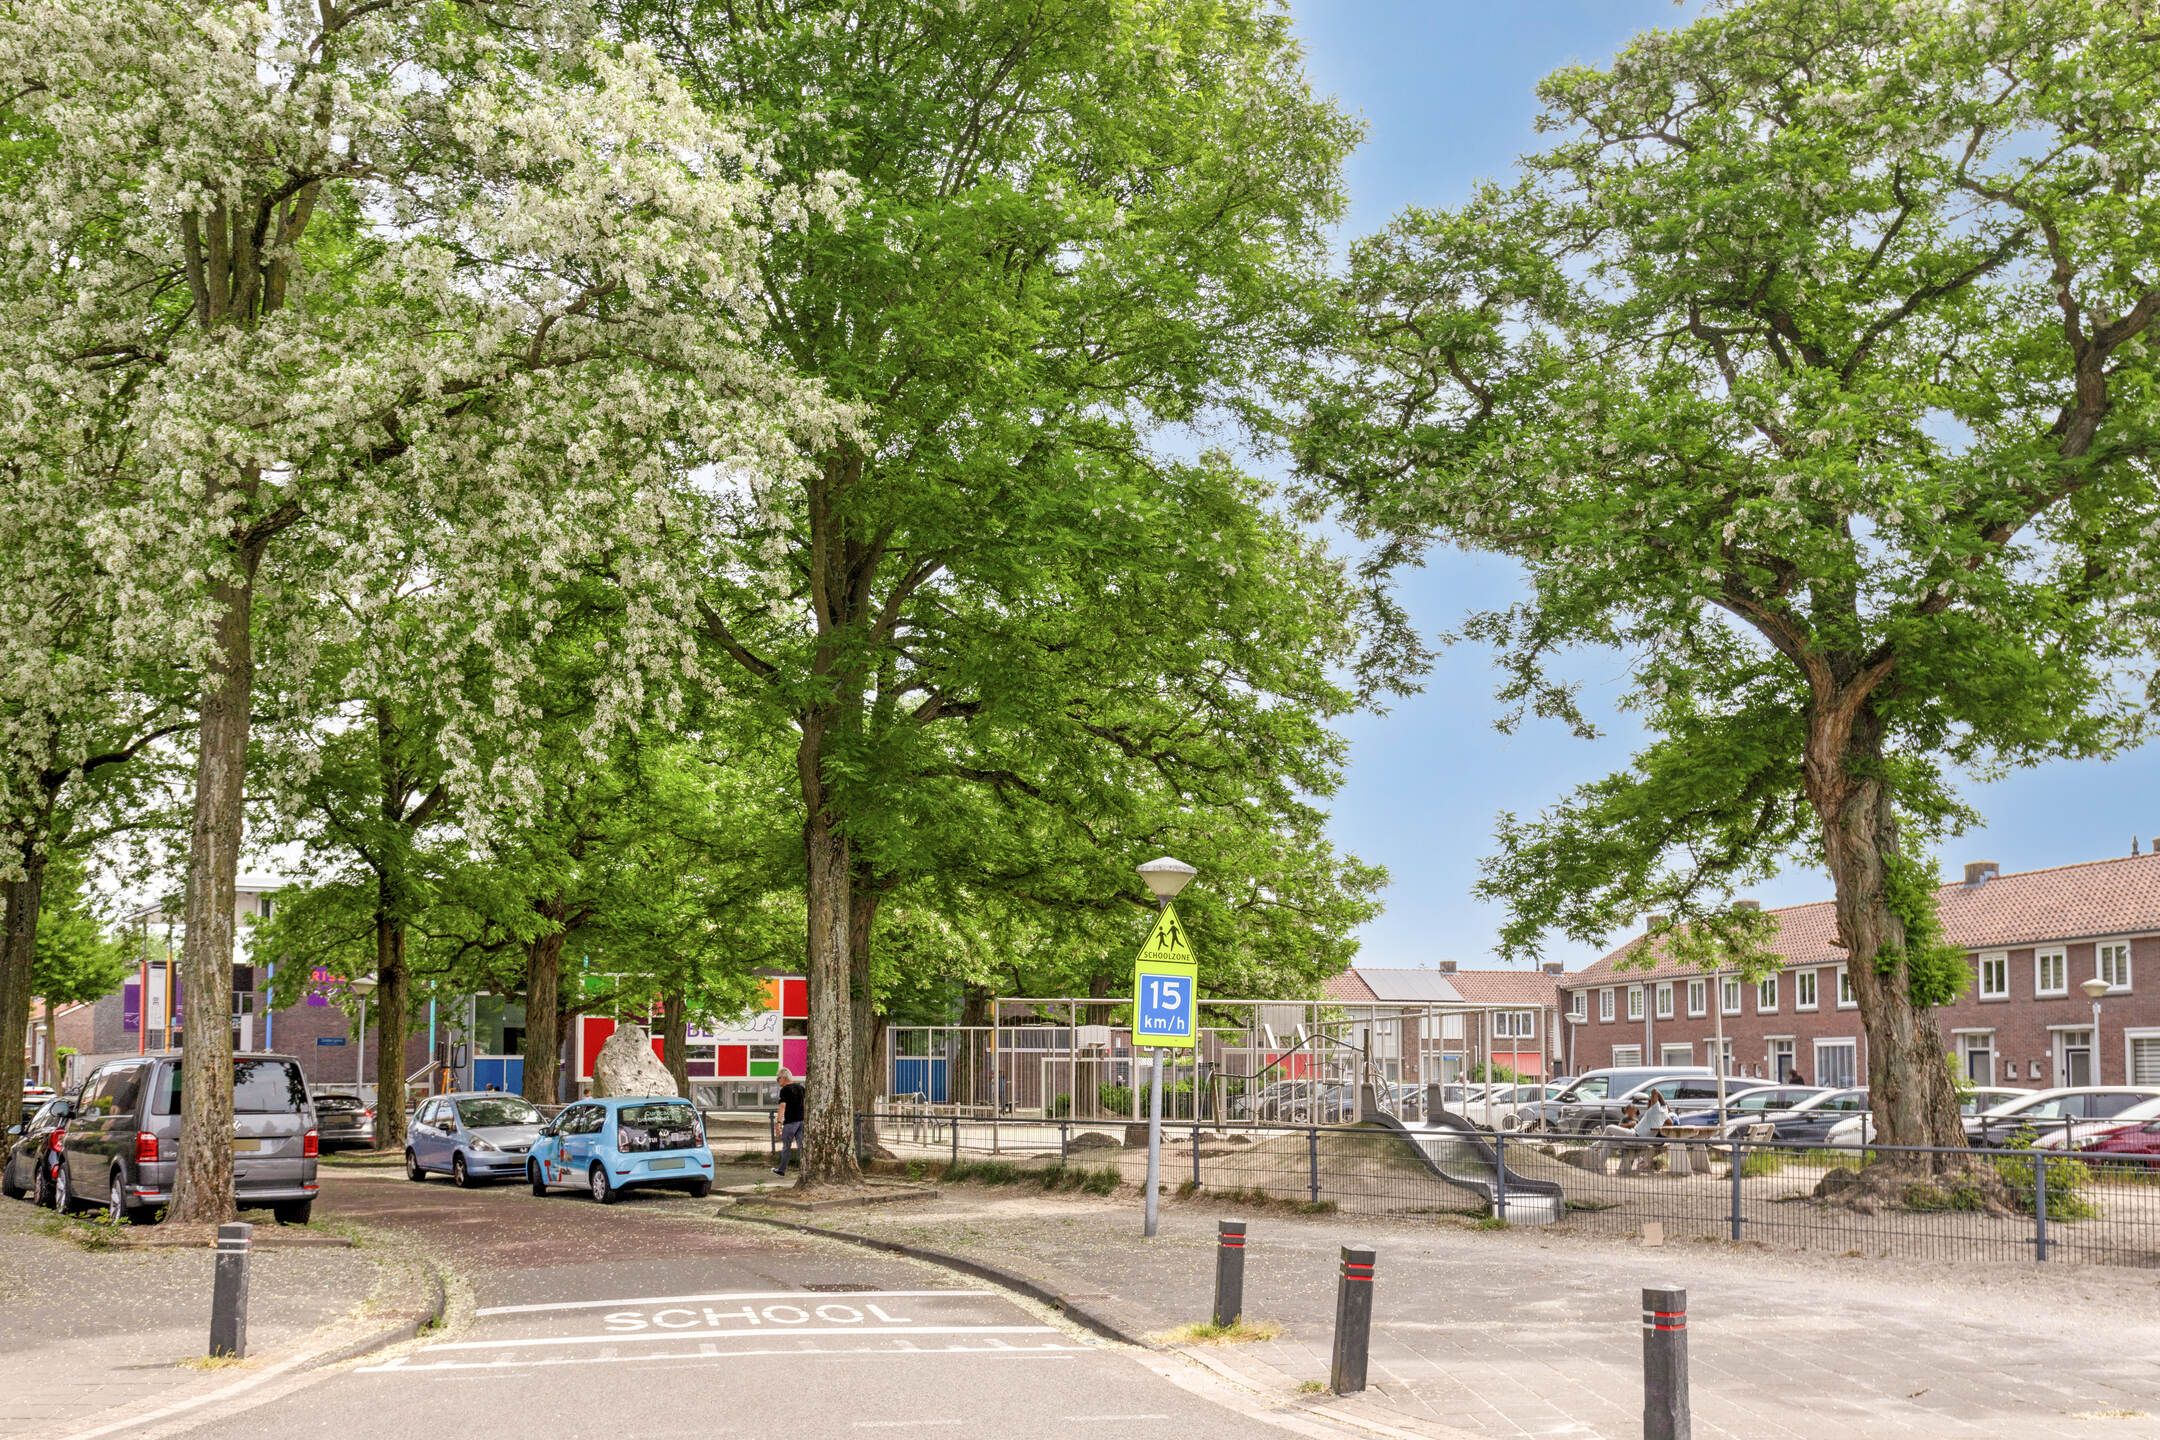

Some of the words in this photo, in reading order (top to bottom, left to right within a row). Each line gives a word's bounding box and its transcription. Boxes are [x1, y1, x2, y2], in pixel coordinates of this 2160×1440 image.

[1144, 951, 1191, 961] SCHOOLZONE
[1150, 981, 1182, 1010] 15
[1144, 1014, 1185, 1031] km/h
[603, 1303, 912, 1331] SCHOOL
